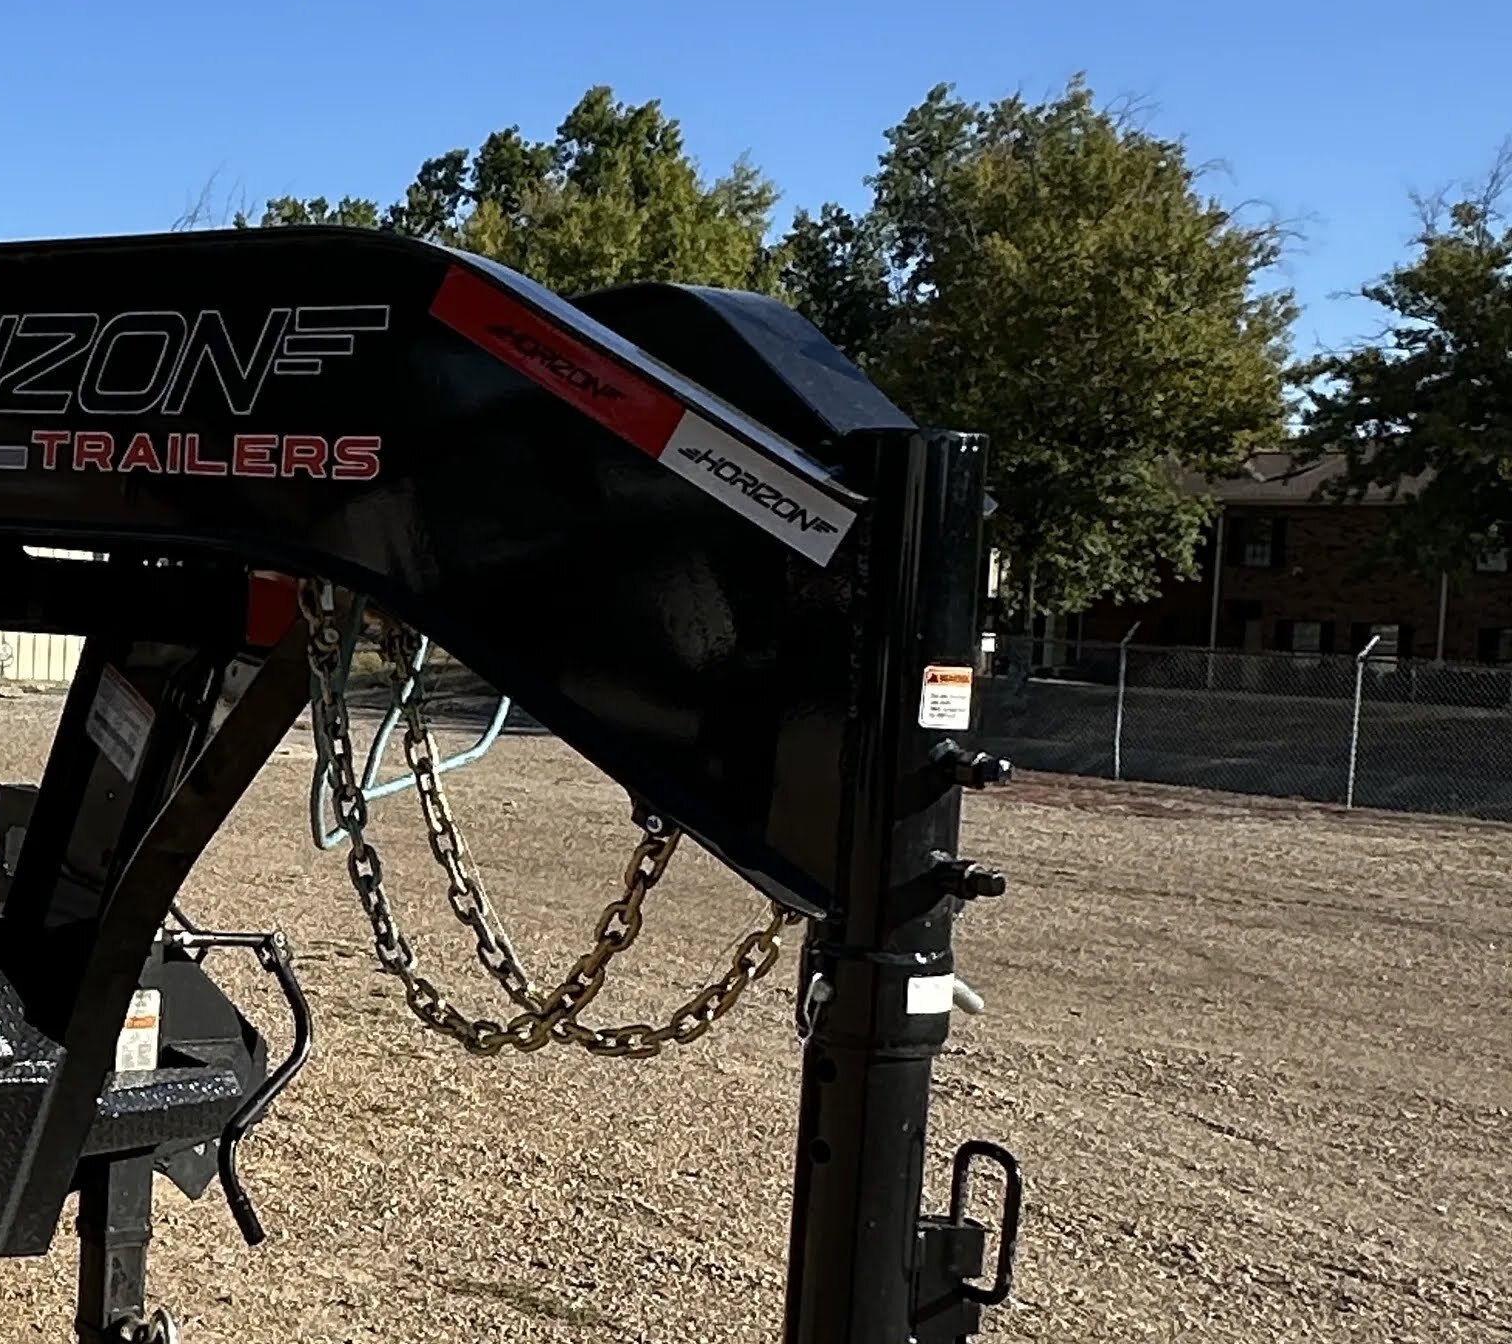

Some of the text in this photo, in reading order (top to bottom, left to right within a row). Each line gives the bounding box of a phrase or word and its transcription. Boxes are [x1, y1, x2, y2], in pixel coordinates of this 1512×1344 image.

[506, 325, 612, 400] HORIZON
[32, 430, 381, 480] TRAILERS
[690, 446, 825, 533] HORIZON
